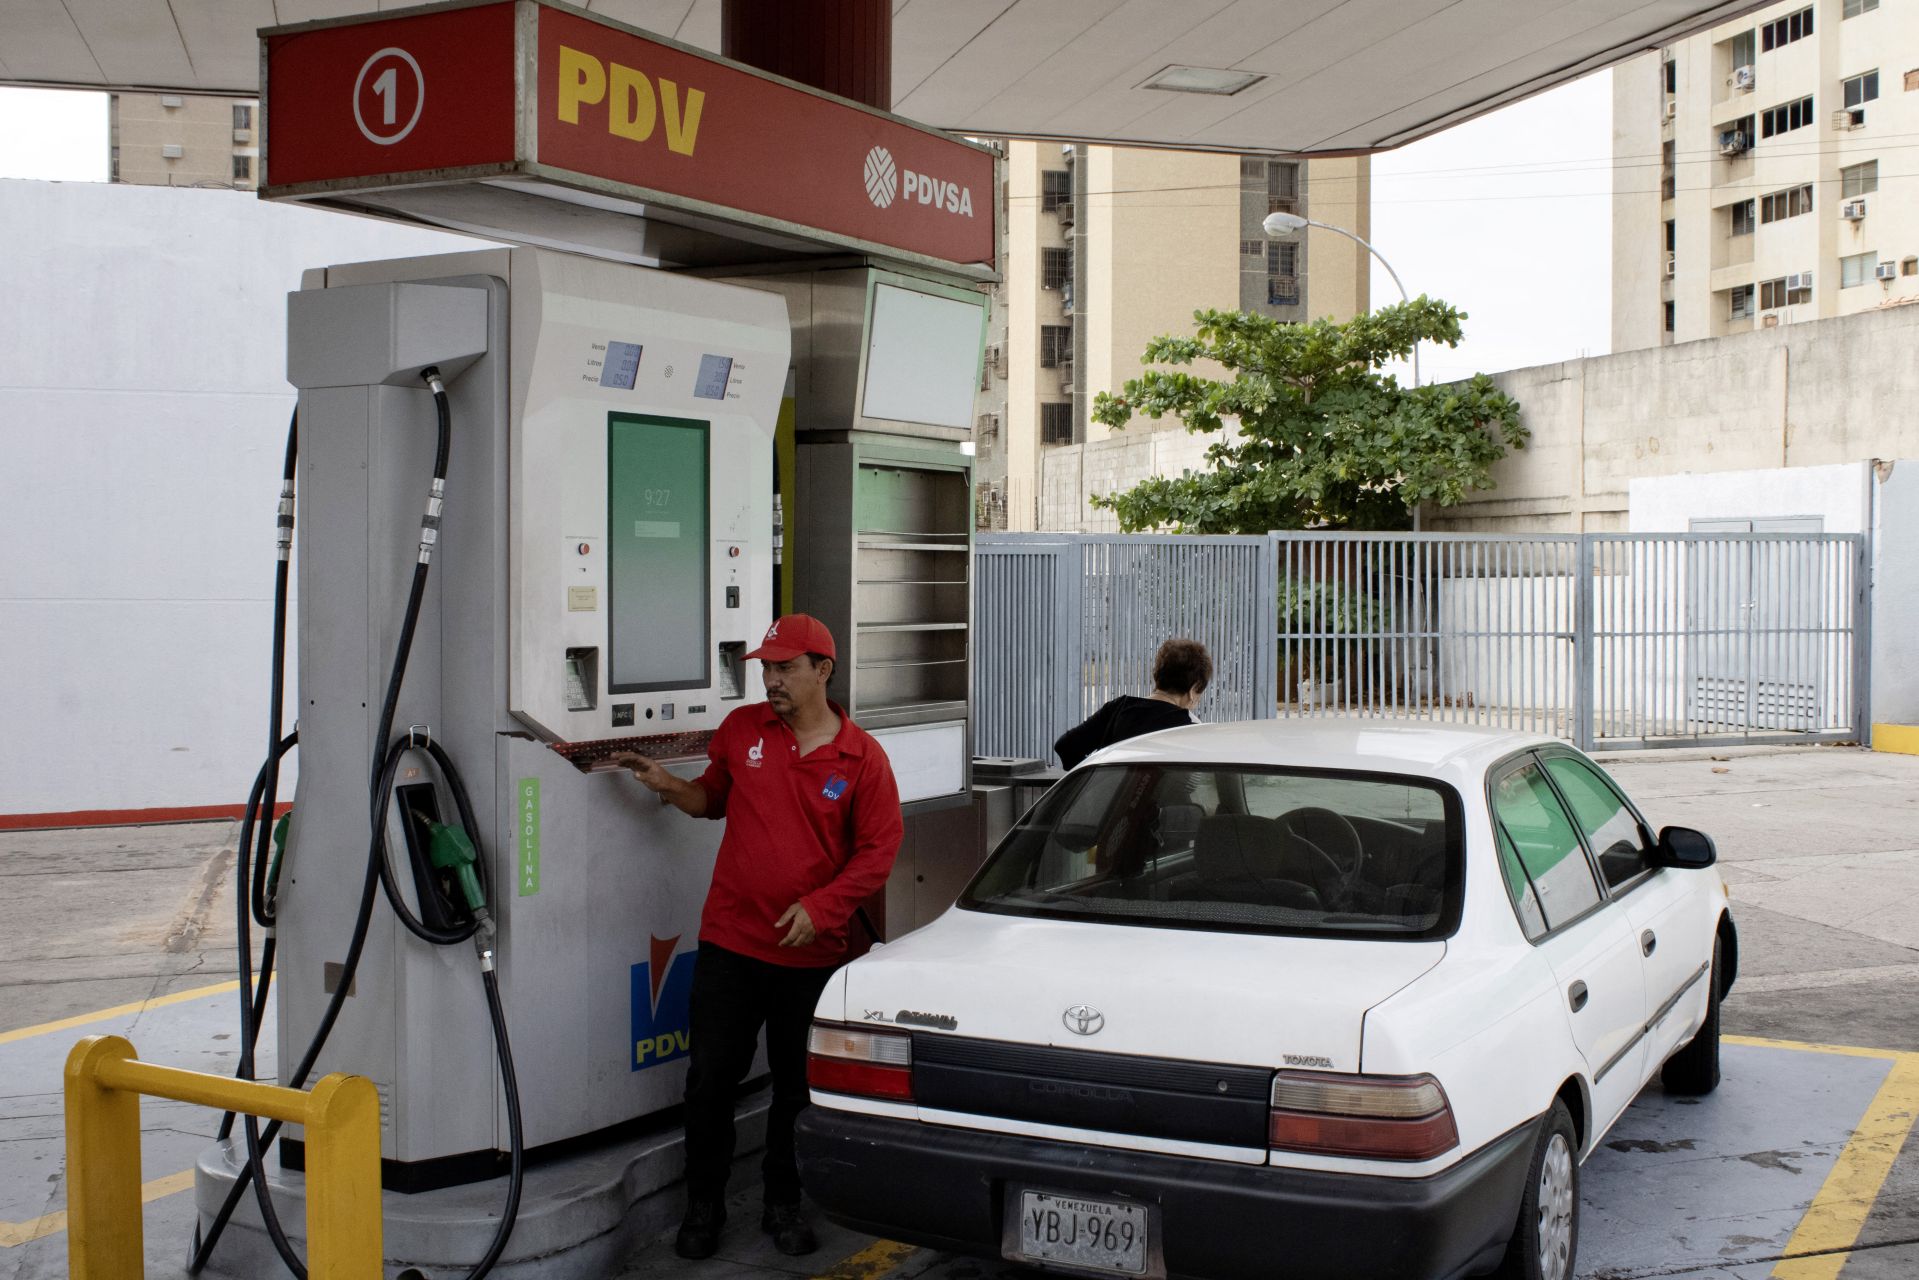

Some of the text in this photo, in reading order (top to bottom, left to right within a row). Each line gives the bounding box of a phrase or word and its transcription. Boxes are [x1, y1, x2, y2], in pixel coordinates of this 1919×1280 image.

[371, 67, 398, 126] 1
[558, 44, 706, 157] PDV
[902, 168, 974, 219] PDVSA
[822, 788, 840, 800] PDV
[525, 786, 534, 888] GASOLINA
[863, 1008, 894, 1023] XL
[1283, 1054, 1334, 1069] TOYOTA
[1031, 1208, 1135, 1253] YBJ-969
[1055, 1200, 1113, 1216] VENEZUELA
